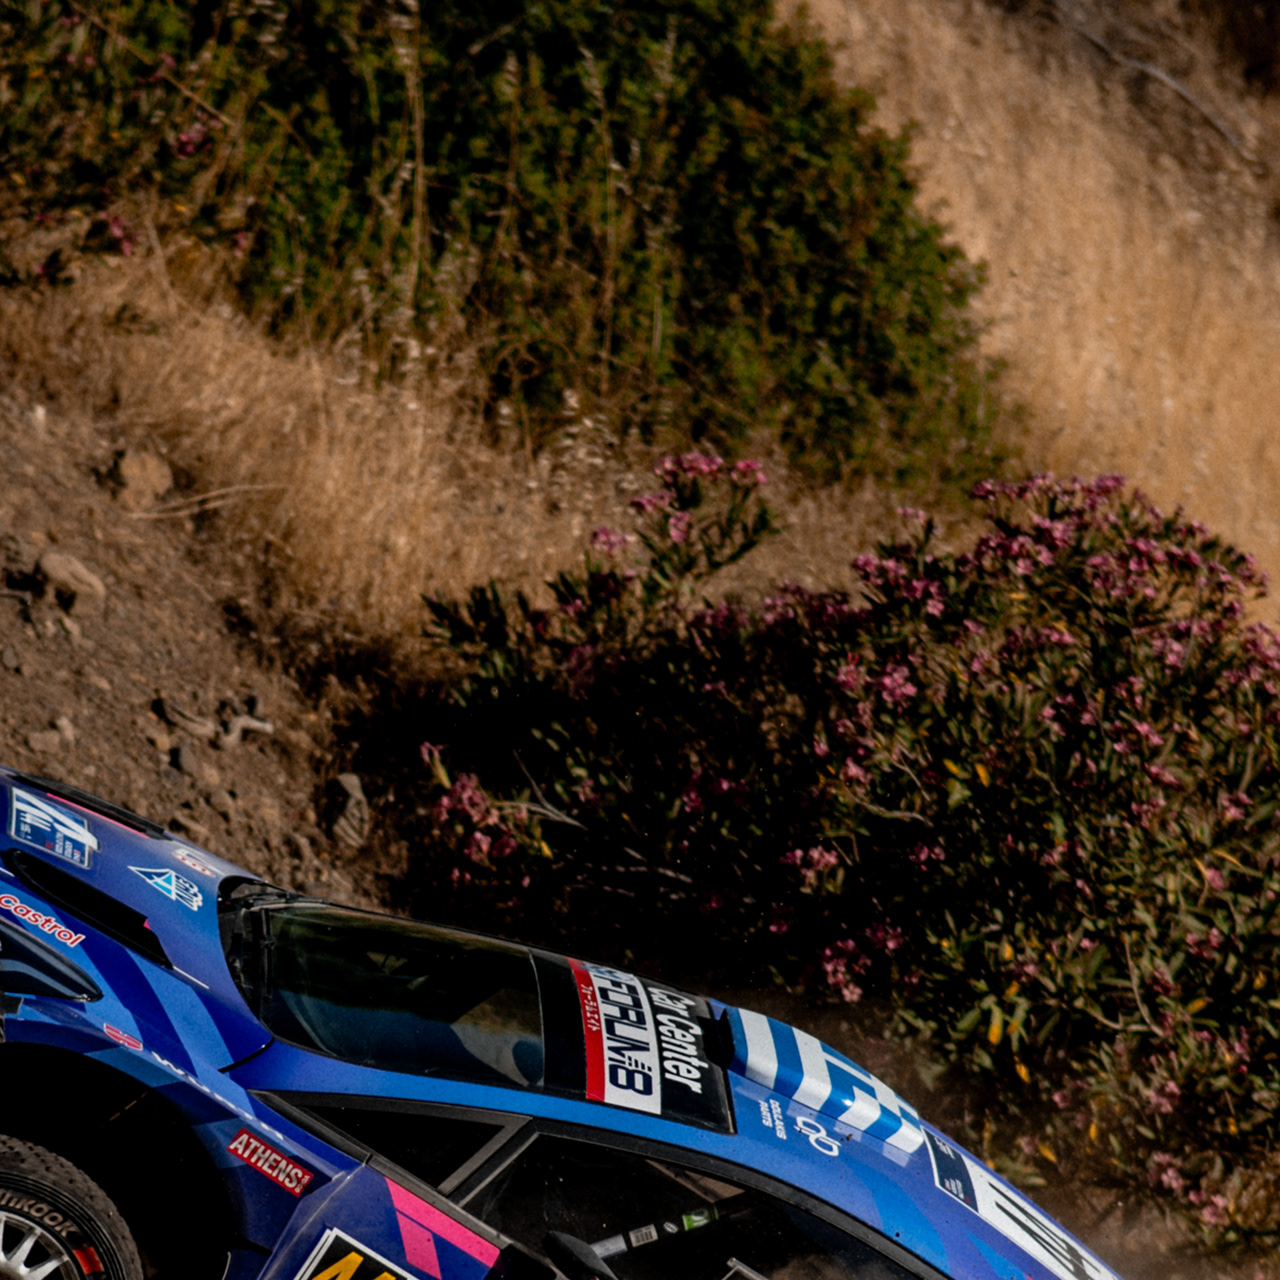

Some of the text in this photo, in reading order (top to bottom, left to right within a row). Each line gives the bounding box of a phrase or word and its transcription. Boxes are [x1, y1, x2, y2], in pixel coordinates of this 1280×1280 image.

[594, 974, 653, 1096] FORUM8
[648, 986, 709, 1094] Car Center
[229, 1133, 303, 1192] ATHENS
